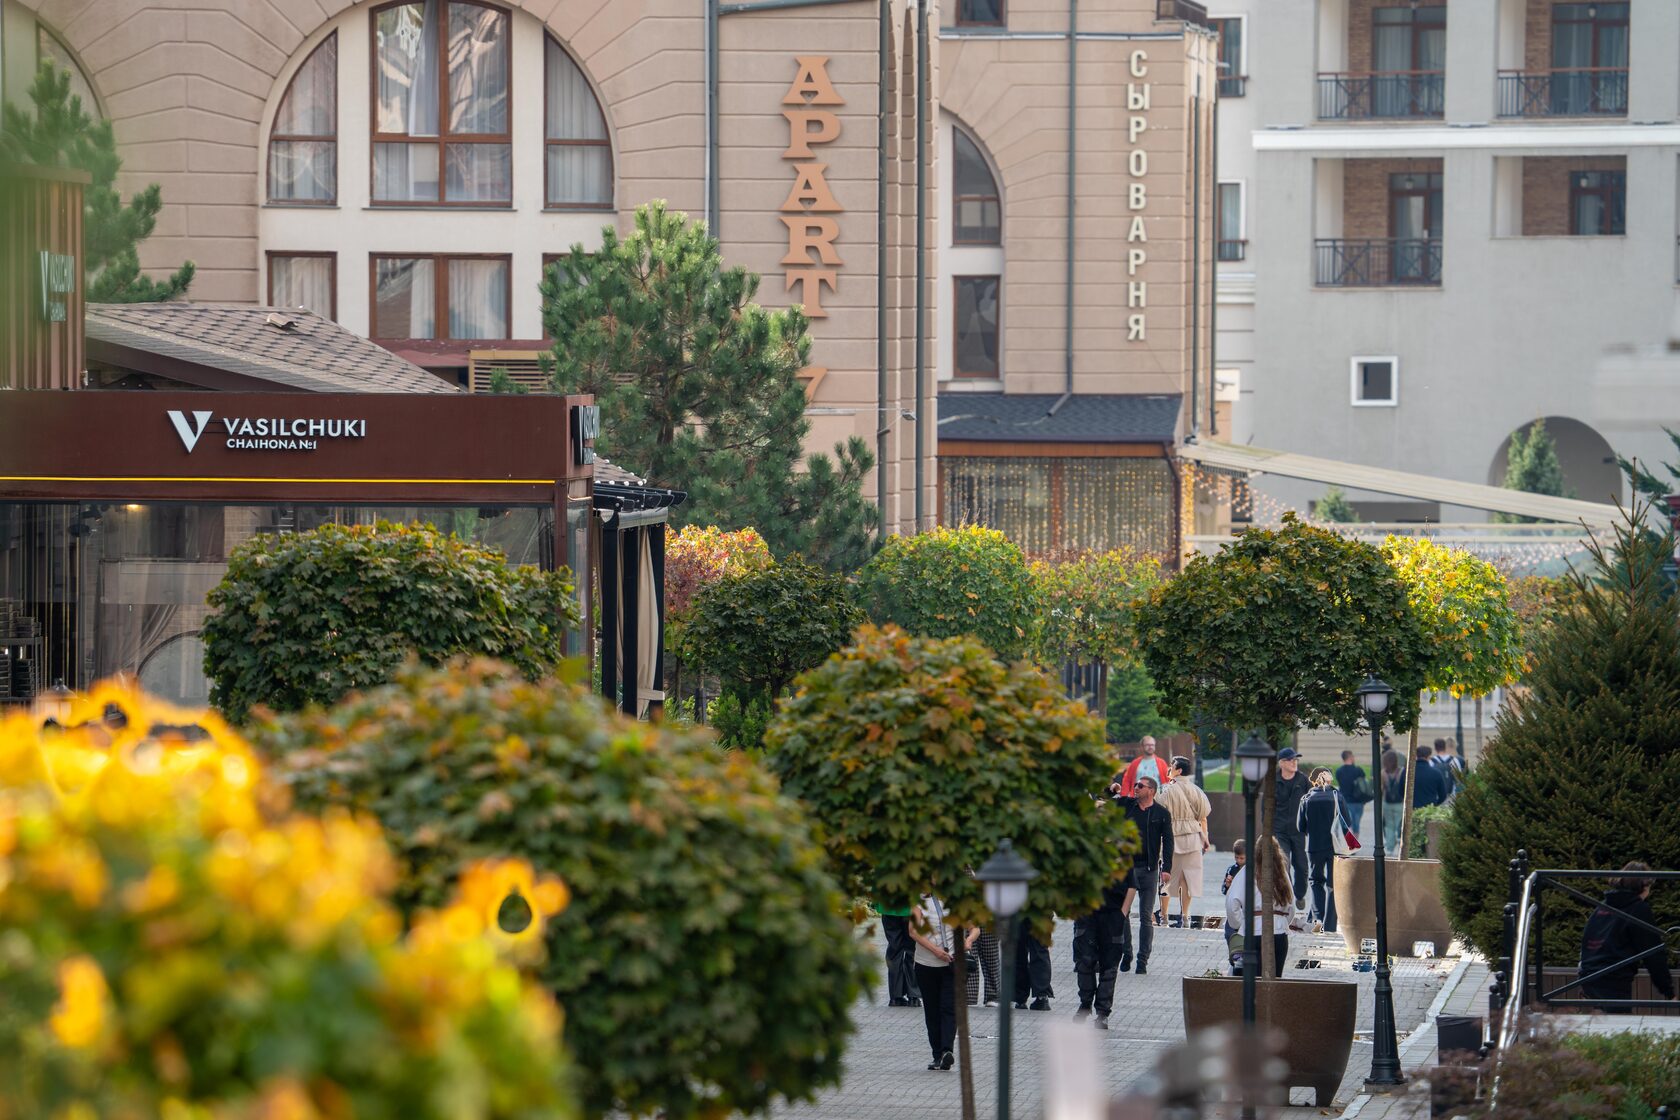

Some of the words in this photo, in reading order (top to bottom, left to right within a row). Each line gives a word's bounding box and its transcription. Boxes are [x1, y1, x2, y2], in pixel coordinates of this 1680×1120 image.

[778, 56, 846, 318] APART
[1127, 49, 1150, 341] СЫРОВАРНЯ
[223, 417, 366, 437] VASILCHUKI
[226, 438, 297, 449] CHAIHONA
